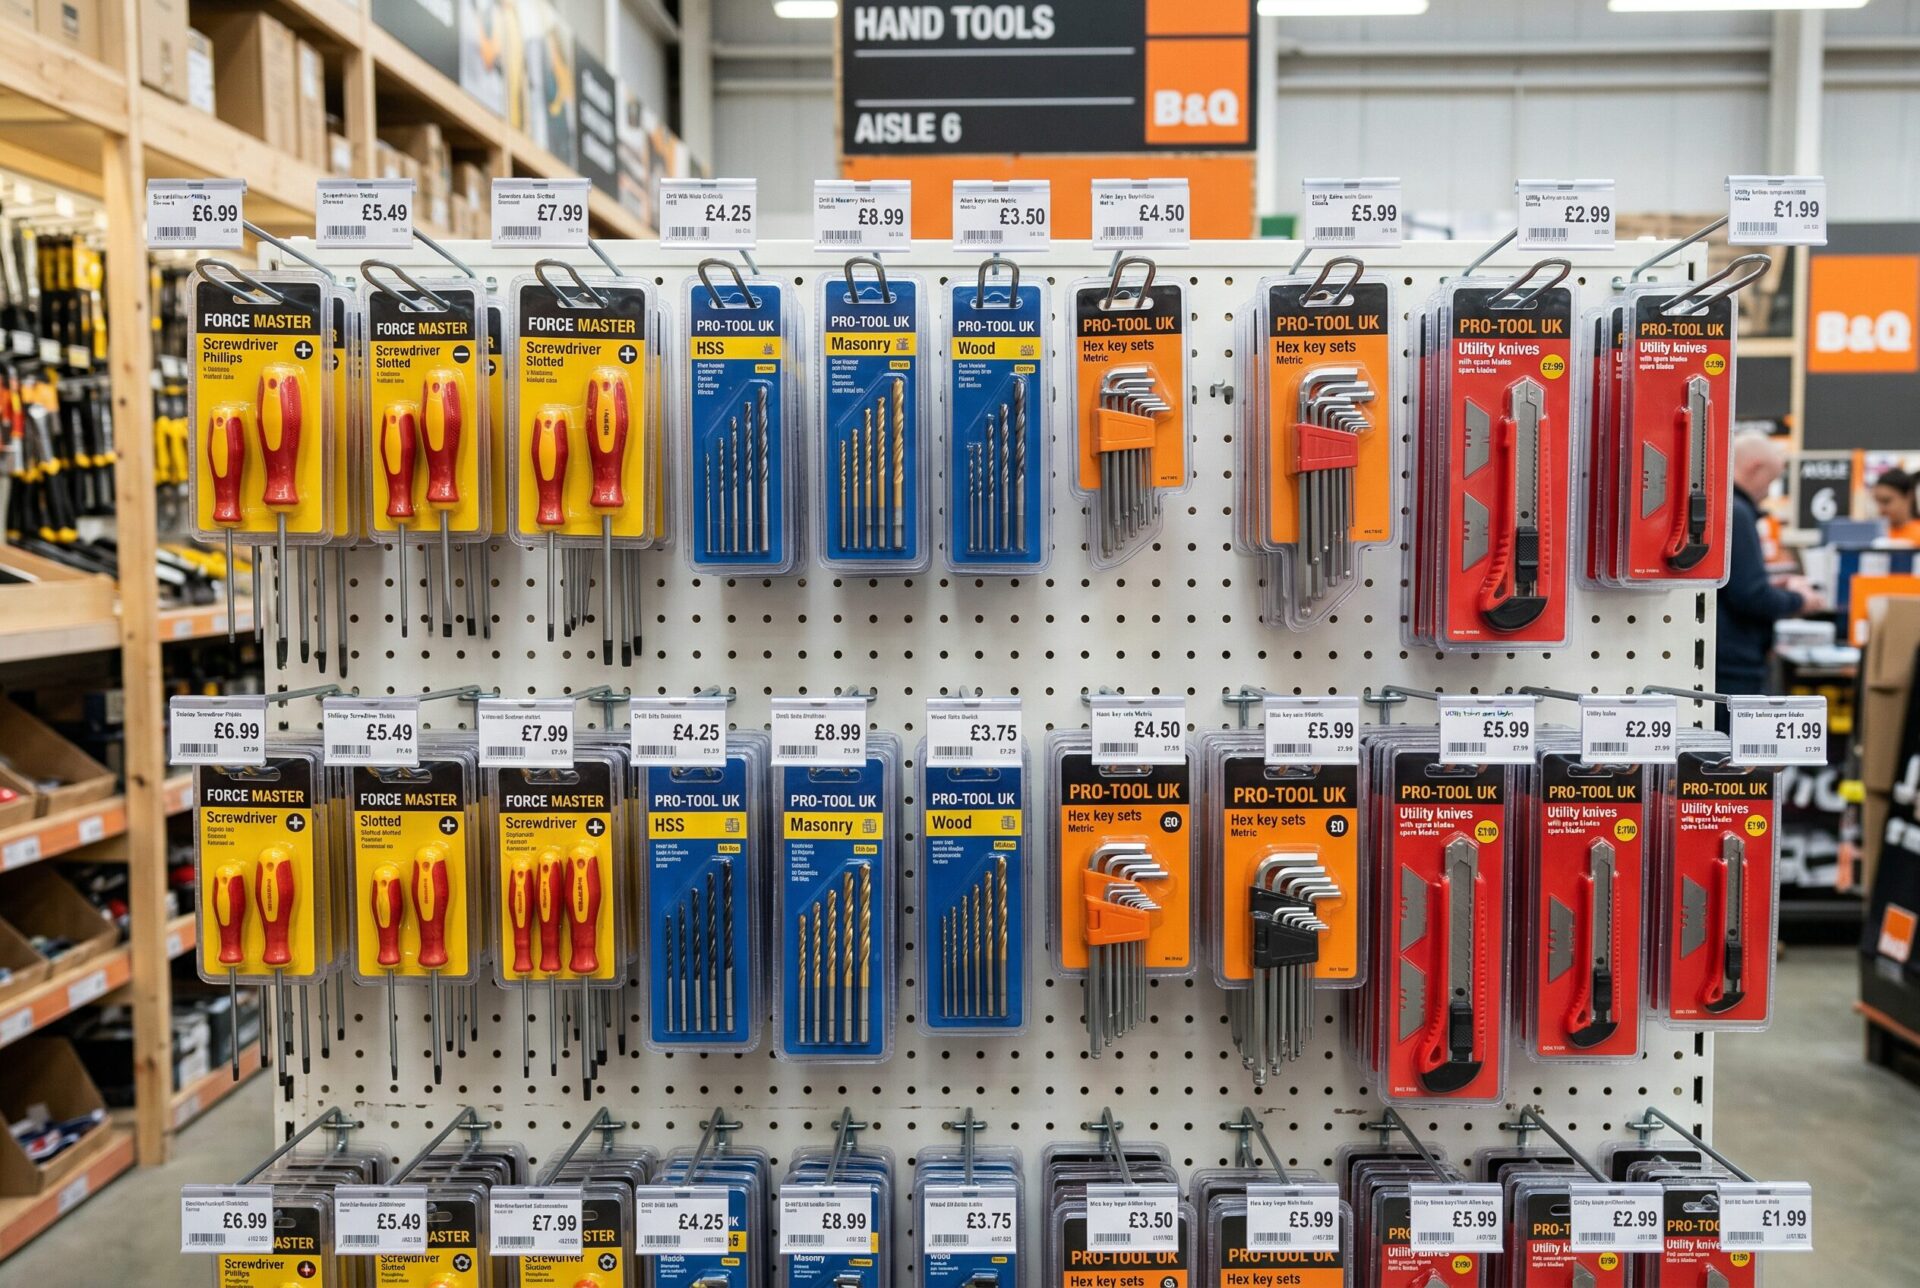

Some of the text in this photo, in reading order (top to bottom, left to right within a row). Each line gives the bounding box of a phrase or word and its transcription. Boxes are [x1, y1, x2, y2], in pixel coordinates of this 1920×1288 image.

[854, 5, 1055, 40] HAND TOOLS
[1153, 89, 1239, 126] B&Q
[855, 113, 962, 143] AISLE 6
[193, 205, 238, 221] £6.99
[362, 204, 407, 221] £5.49
[537, 204, 583, 221] £7.99
[706, 205, 751, 222] £4.25
[858, 208, 904, 225] £8.99
[1000, 208, 1045, 225] £3.50
[1139, 205, 1184, 221] £4.50
[1352, 205, 1397, 221] £5.99
[1565, 206, 1610, 223] £2.99
[1774, 201, 1819, 218] £1.99
[205, 314, 311, 329] FORCE MASTER
[377, 322, 467, 335] FORCE MASTER
[528, 317, 635, 333] FORCE MASTER
[697, 320, 774, 332] PRO-TOOL UK
[831, 316, 909, 327] PRO-TOOL UK
[958, 321, 1035, 332] PRO-TOOL UK
[1083, 317, 1174, 332] PRO-TOOL UK
[1277, 315, 1379, 331] PRO-TOOL UK
[1460, 319, 1563, 333] PRO-TOOL UK
[1641, 324, 1724, 336] PRO-TOOL UK
[1816, 311, 1911, 352] B&Q
[203, 338, 278, 351] Screwdriver
[376, 345, 440, 356] Screwdriver
[526, 342, 601, 355] Screwdriver
[697, 342, 724, 354] HSS
[832, 337, 890, 353] Masonry
[958, 341, 995, 354] Wood
[1084, 340, 1154, 353] Hex key sets
[1277, 340, 1356, 355] Hex key sets
[1459, 342, 1539, 357] Utility knives
[1640, 342, 1707, 354] Utility knives
[203, 352, 242, 365] Phillips
[376, 359, 410, 368] Slotted
[526, 356, 563, 367] Slotted
[1084, 354, 1108, 362] Metric
[1277, 356, 1303, 364] Metric
[1811, 487, 1838, 522] 6
[214, 722, 259, 739] £6.99
[366, 724, 412, 740] £5.49
[522, 725, 567, 741] £7.99
[673, 724, 719, 740] £4.25
[815, 724, 860, 740] £8.99
[970, 725, 1016, 741] £3.75
[1134, 721, 1180, 738] £4.50
[1308, 722, 1353, 738] £5.99
[1483, 721, 1529, 737] £5.99
[1626, 721, 1671, 737] £2.99
[1776, 723, 1821, 739] £1.99
[207, 789, 304, 802] FORCE MASTER
[1070, 783, 1180, 799] PRO-TOOL UK
[1234, 787, 1346, 803] PRO-TOOL UK
[1402, 786, 1497, 799] PRO-TOOL UK
[1549, 786, 1636, 798] PRO-TOOL UK
[1683, 783, 1767, 795] PRO-TOOL UK
[361, 793, 457, 805] FORCE MASTER
[506, 795, 604, 807] FORCE MASTER
[655, 795, 739, 807] PRO-TOOL UK
[791, 795, 876, 807] PRO-TOOL UK
[932, 793, 1014, 805] PRO-TOOL UK
[1069, 810, 1141, 823] Hex key sets
[1400, 808, 1473, 821] Utility knives
[1548, 807, 1617, 820] Utility knives
[1681, 803, 1749, 816] Utility knives
[207, 811, 277, 824] Screwdriver
[361, 815, 401, 826] Slotted
[506, 817, 577, 829] Screwdriver
[932, 815, 971, 829] Wood
[1231, 814, 1305, 827] Hex key sets
[655, 818, 684, 832] HSS
[791, 818, 853, 835] Masonry
[223, 1213, 267, 1229] £6.99
[377, 1214, 420, 1230] £5.49
[533, 1215, 577, 1231] £7.99
[678, 1214, 723, 1230] £4.25
[822, 1213, 866, 1229] £8.99
[967, 1213, 1011, 1229] £3.75
[1129, 1212, 1173, 1228] £3.50
[1289, 1211, 1333, 1228] £5.99
[1453, 1211, 1497, 1227] £5.99
[1614, 1211, 1657, 1227] £2.99
[1763, 1210, 1806, 1226] £1.99
[428, 1230, 470, 1243] ASTER
[584, 1230, 615, 1242] STER
[1533, 1224, 1570, 1235] PRO-T
[273, 1237, 314, 1249] ASTER
[1533, 1244, 1560, 1254] Utility
[1667, 1240, 1721, 1251] Utility knive
[381, 1255, 439, 1263] Screwdriver
[794, 1254, 825, 1263] Masonry
[1388, 1248, 1416, 1258] Utility
[225, 1259, 284, 1271] Screwdriver
[1071, 1276, 1144, 1288] Hex key sets
[1227, 1273, 1300, 1287] Hex key sets
